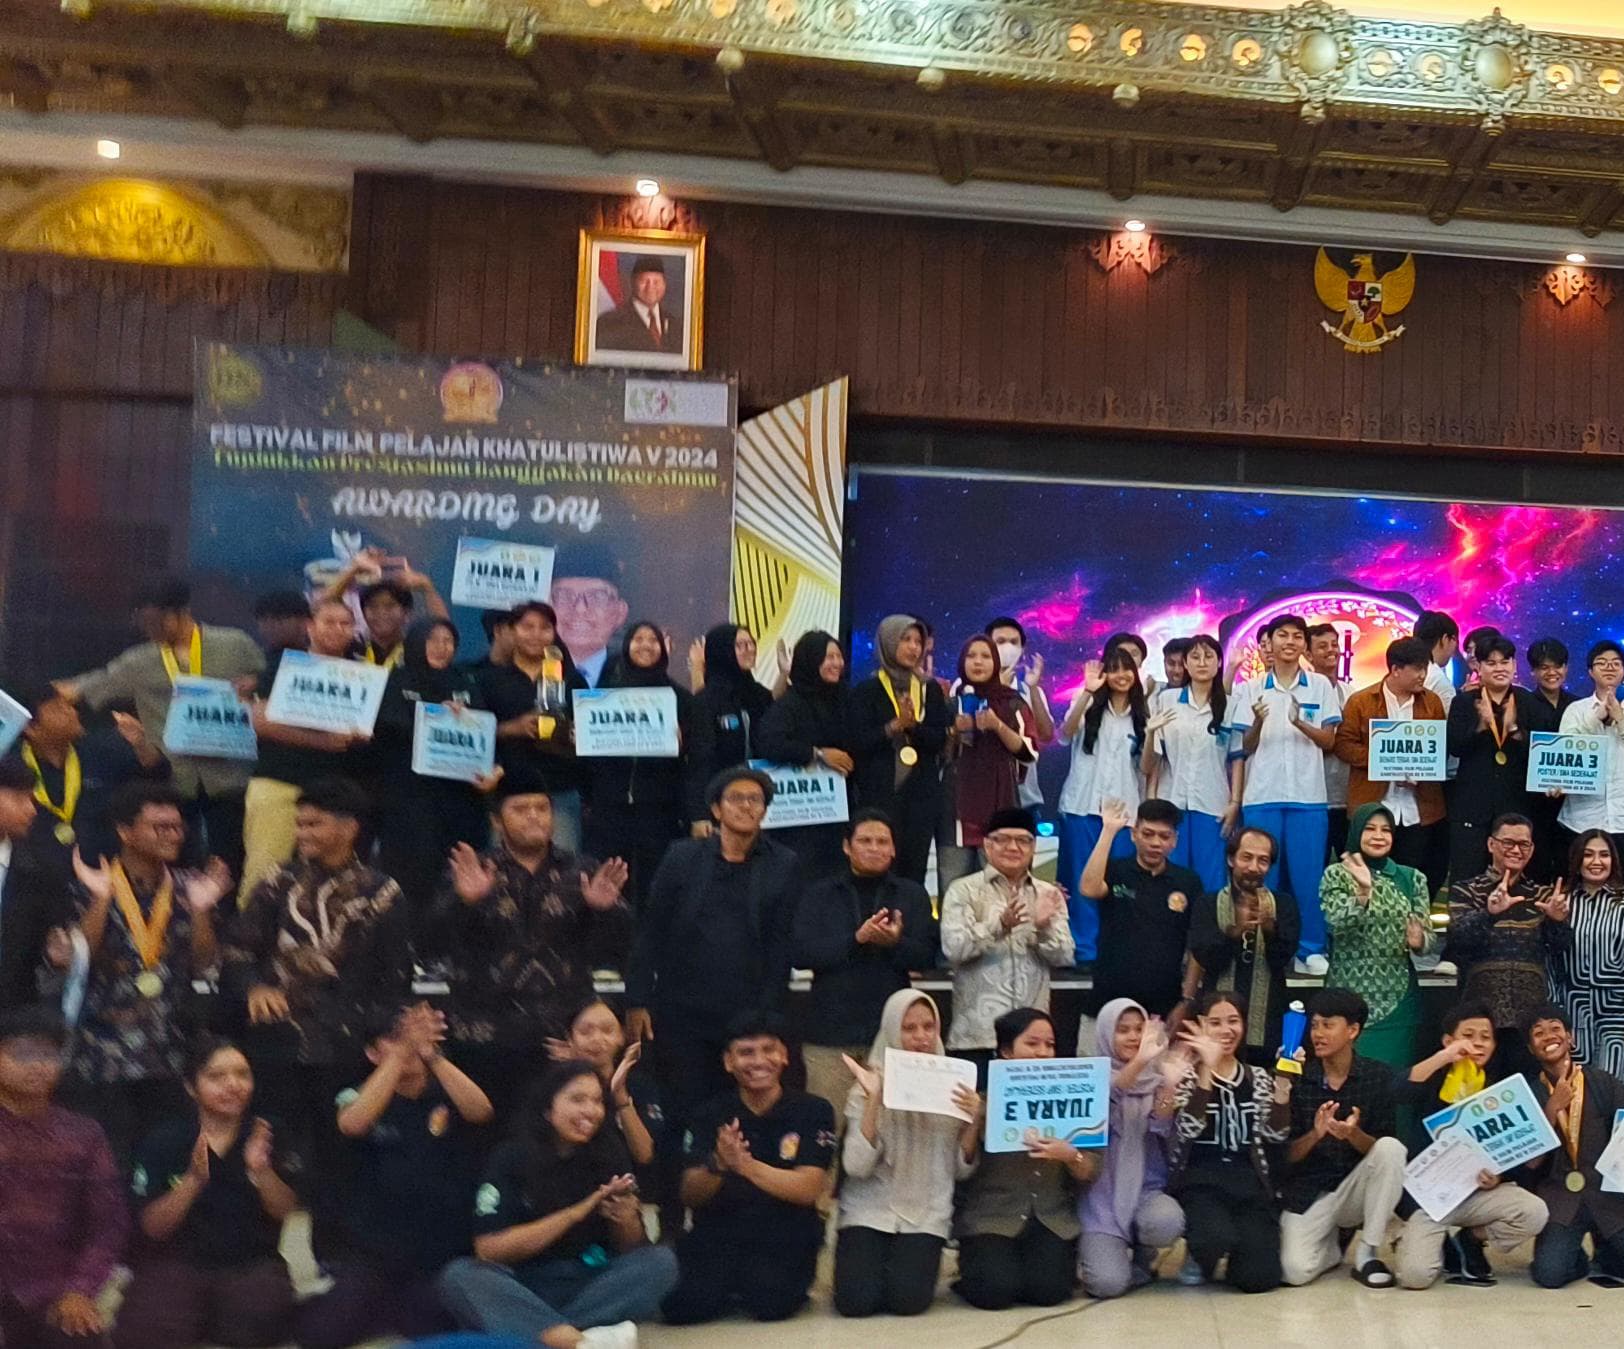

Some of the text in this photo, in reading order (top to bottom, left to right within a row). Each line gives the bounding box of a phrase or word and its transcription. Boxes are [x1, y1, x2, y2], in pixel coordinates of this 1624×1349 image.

[211, 423, 319, 451] FESTIVAL
[380, 432, 479, 458] PELAJAR
[483, 437, 642, 466] KHATULISTIWA
[646, 446, 661, 467] V
[665, 448, 717, 469] 2024
[531, 494, 601, 532] DAY
[471, 560, 525, 580] JUARA
[292, 675, 352, 700] JUARA
[589, 710, 651, 725] JUARA
[1379, 739, 1437, 754] JUARA 3
[1539, 752, 1598, 768] JUARA 3
[774, 778, 822, 796] UARA
[1005, 1098, 1094, 1121] JUARA 3
[1466, 1111, 1515, 1143] ARA
